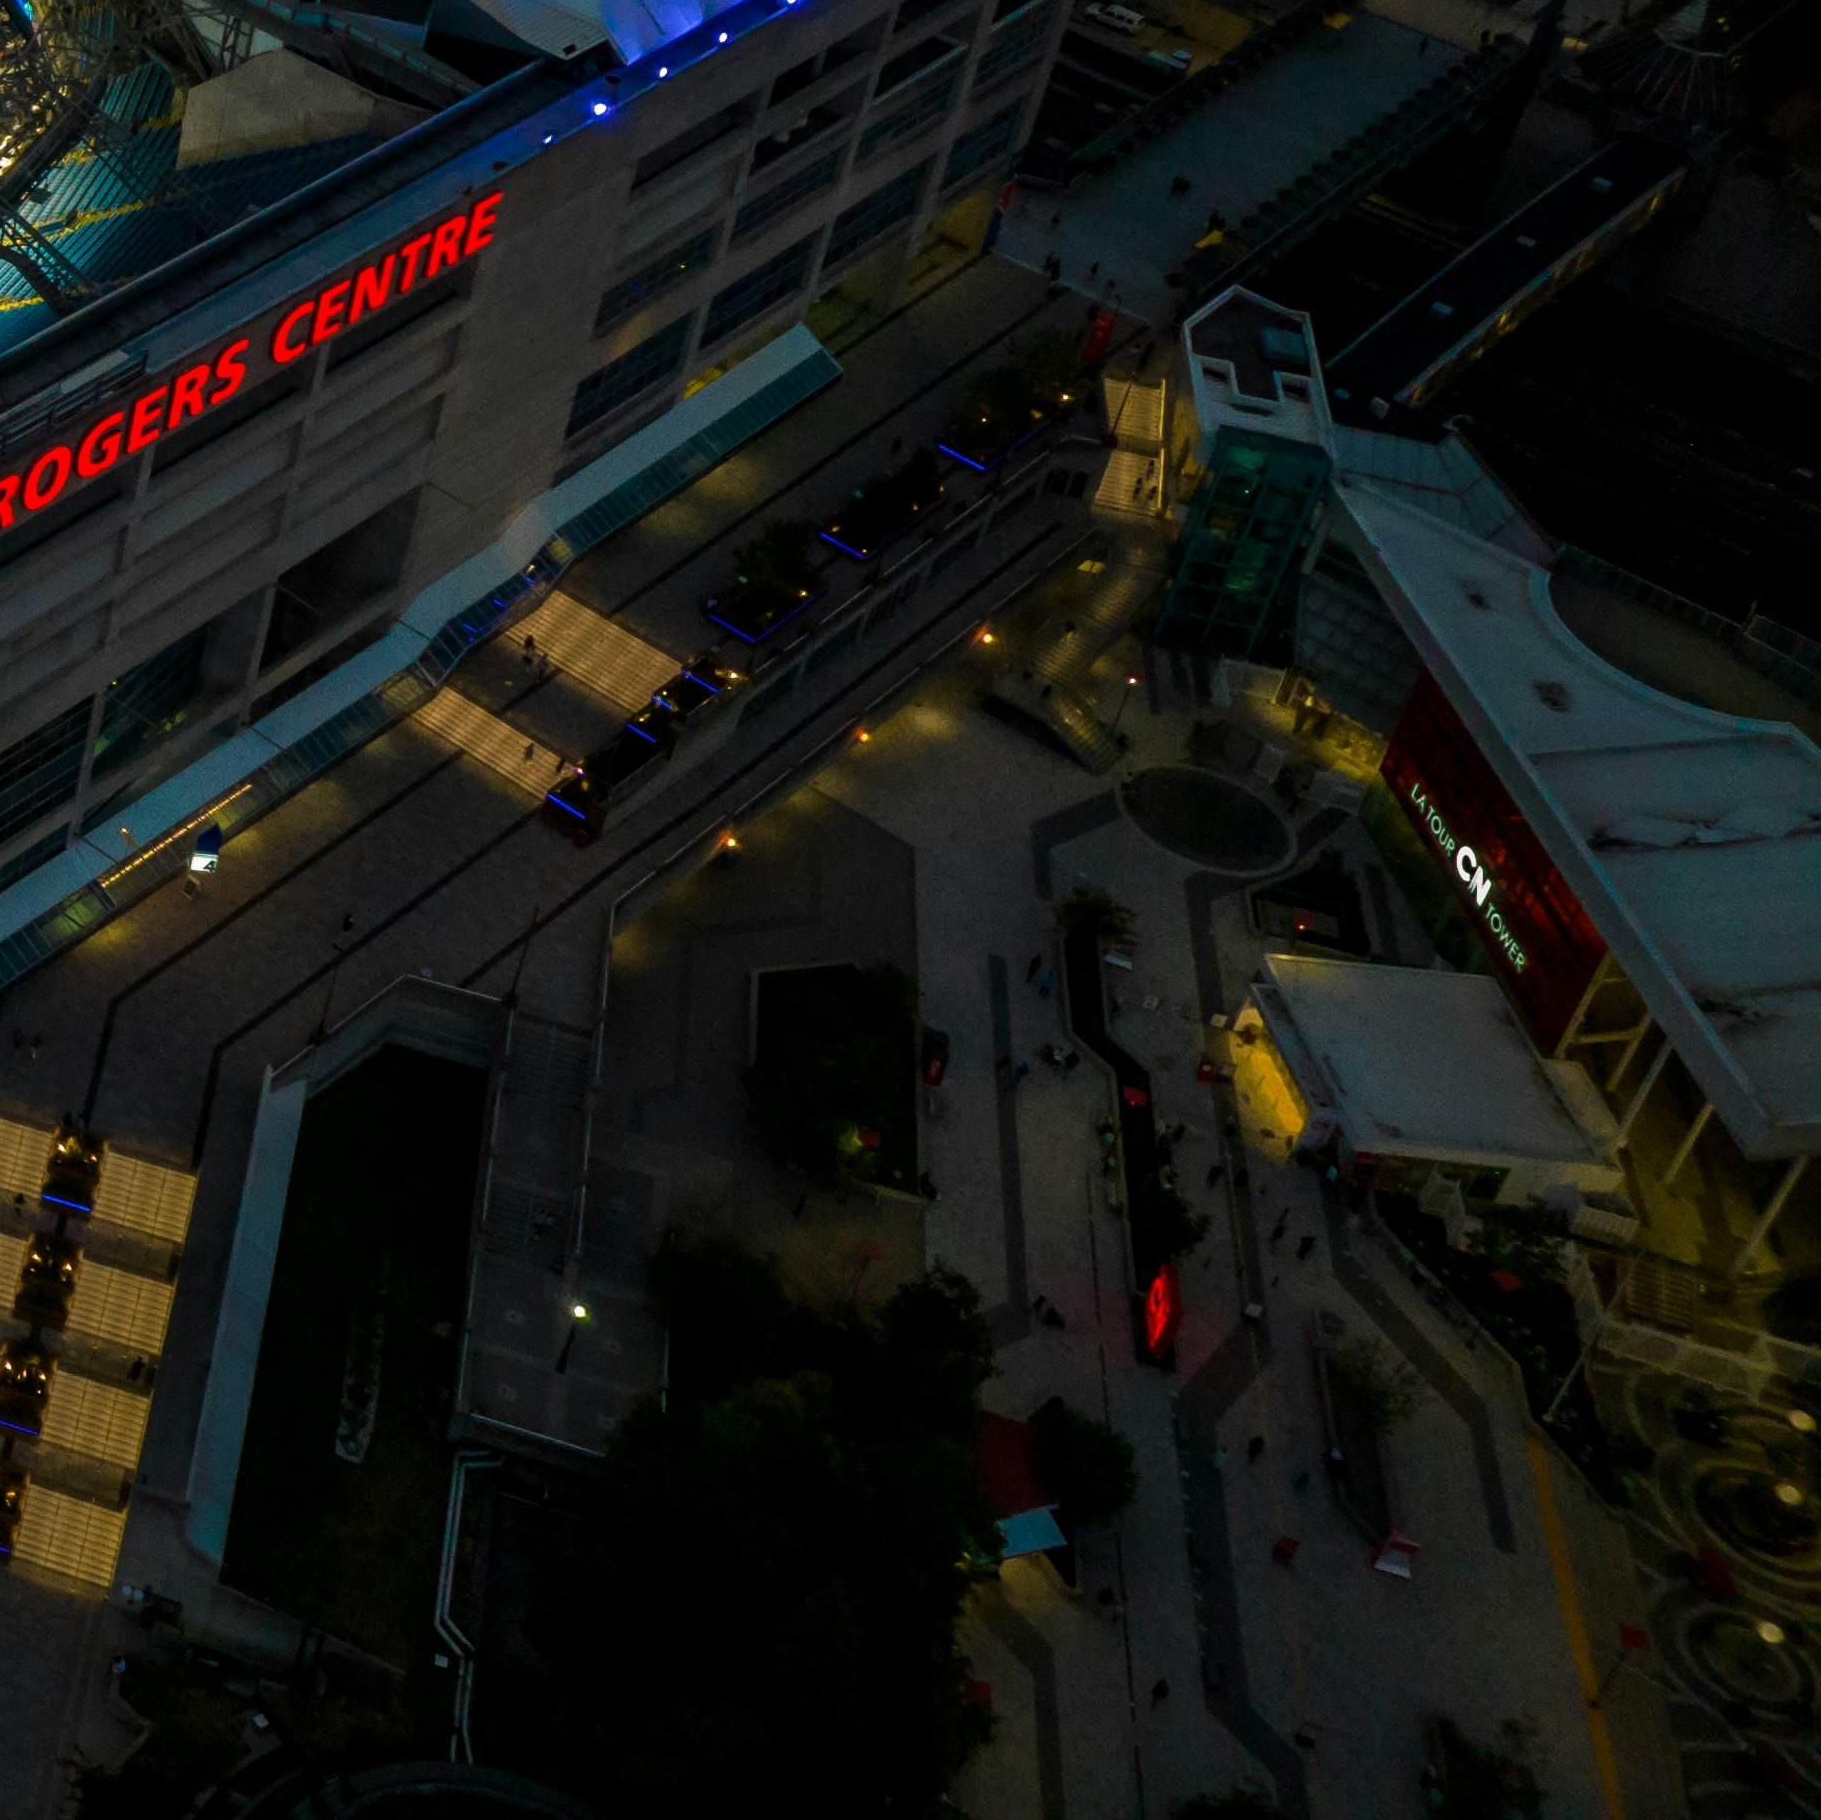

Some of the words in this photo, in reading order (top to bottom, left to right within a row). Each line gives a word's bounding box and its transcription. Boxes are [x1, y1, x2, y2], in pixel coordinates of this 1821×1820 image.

[271, 191, 503, 366] CENTRE
[1410, 782, 1428, 815] LA
[1426, 805, 1456, 858] TOUR
[1456, 845, 1492, 907] CN
[1484, 902, 1527, 974] TOWER
